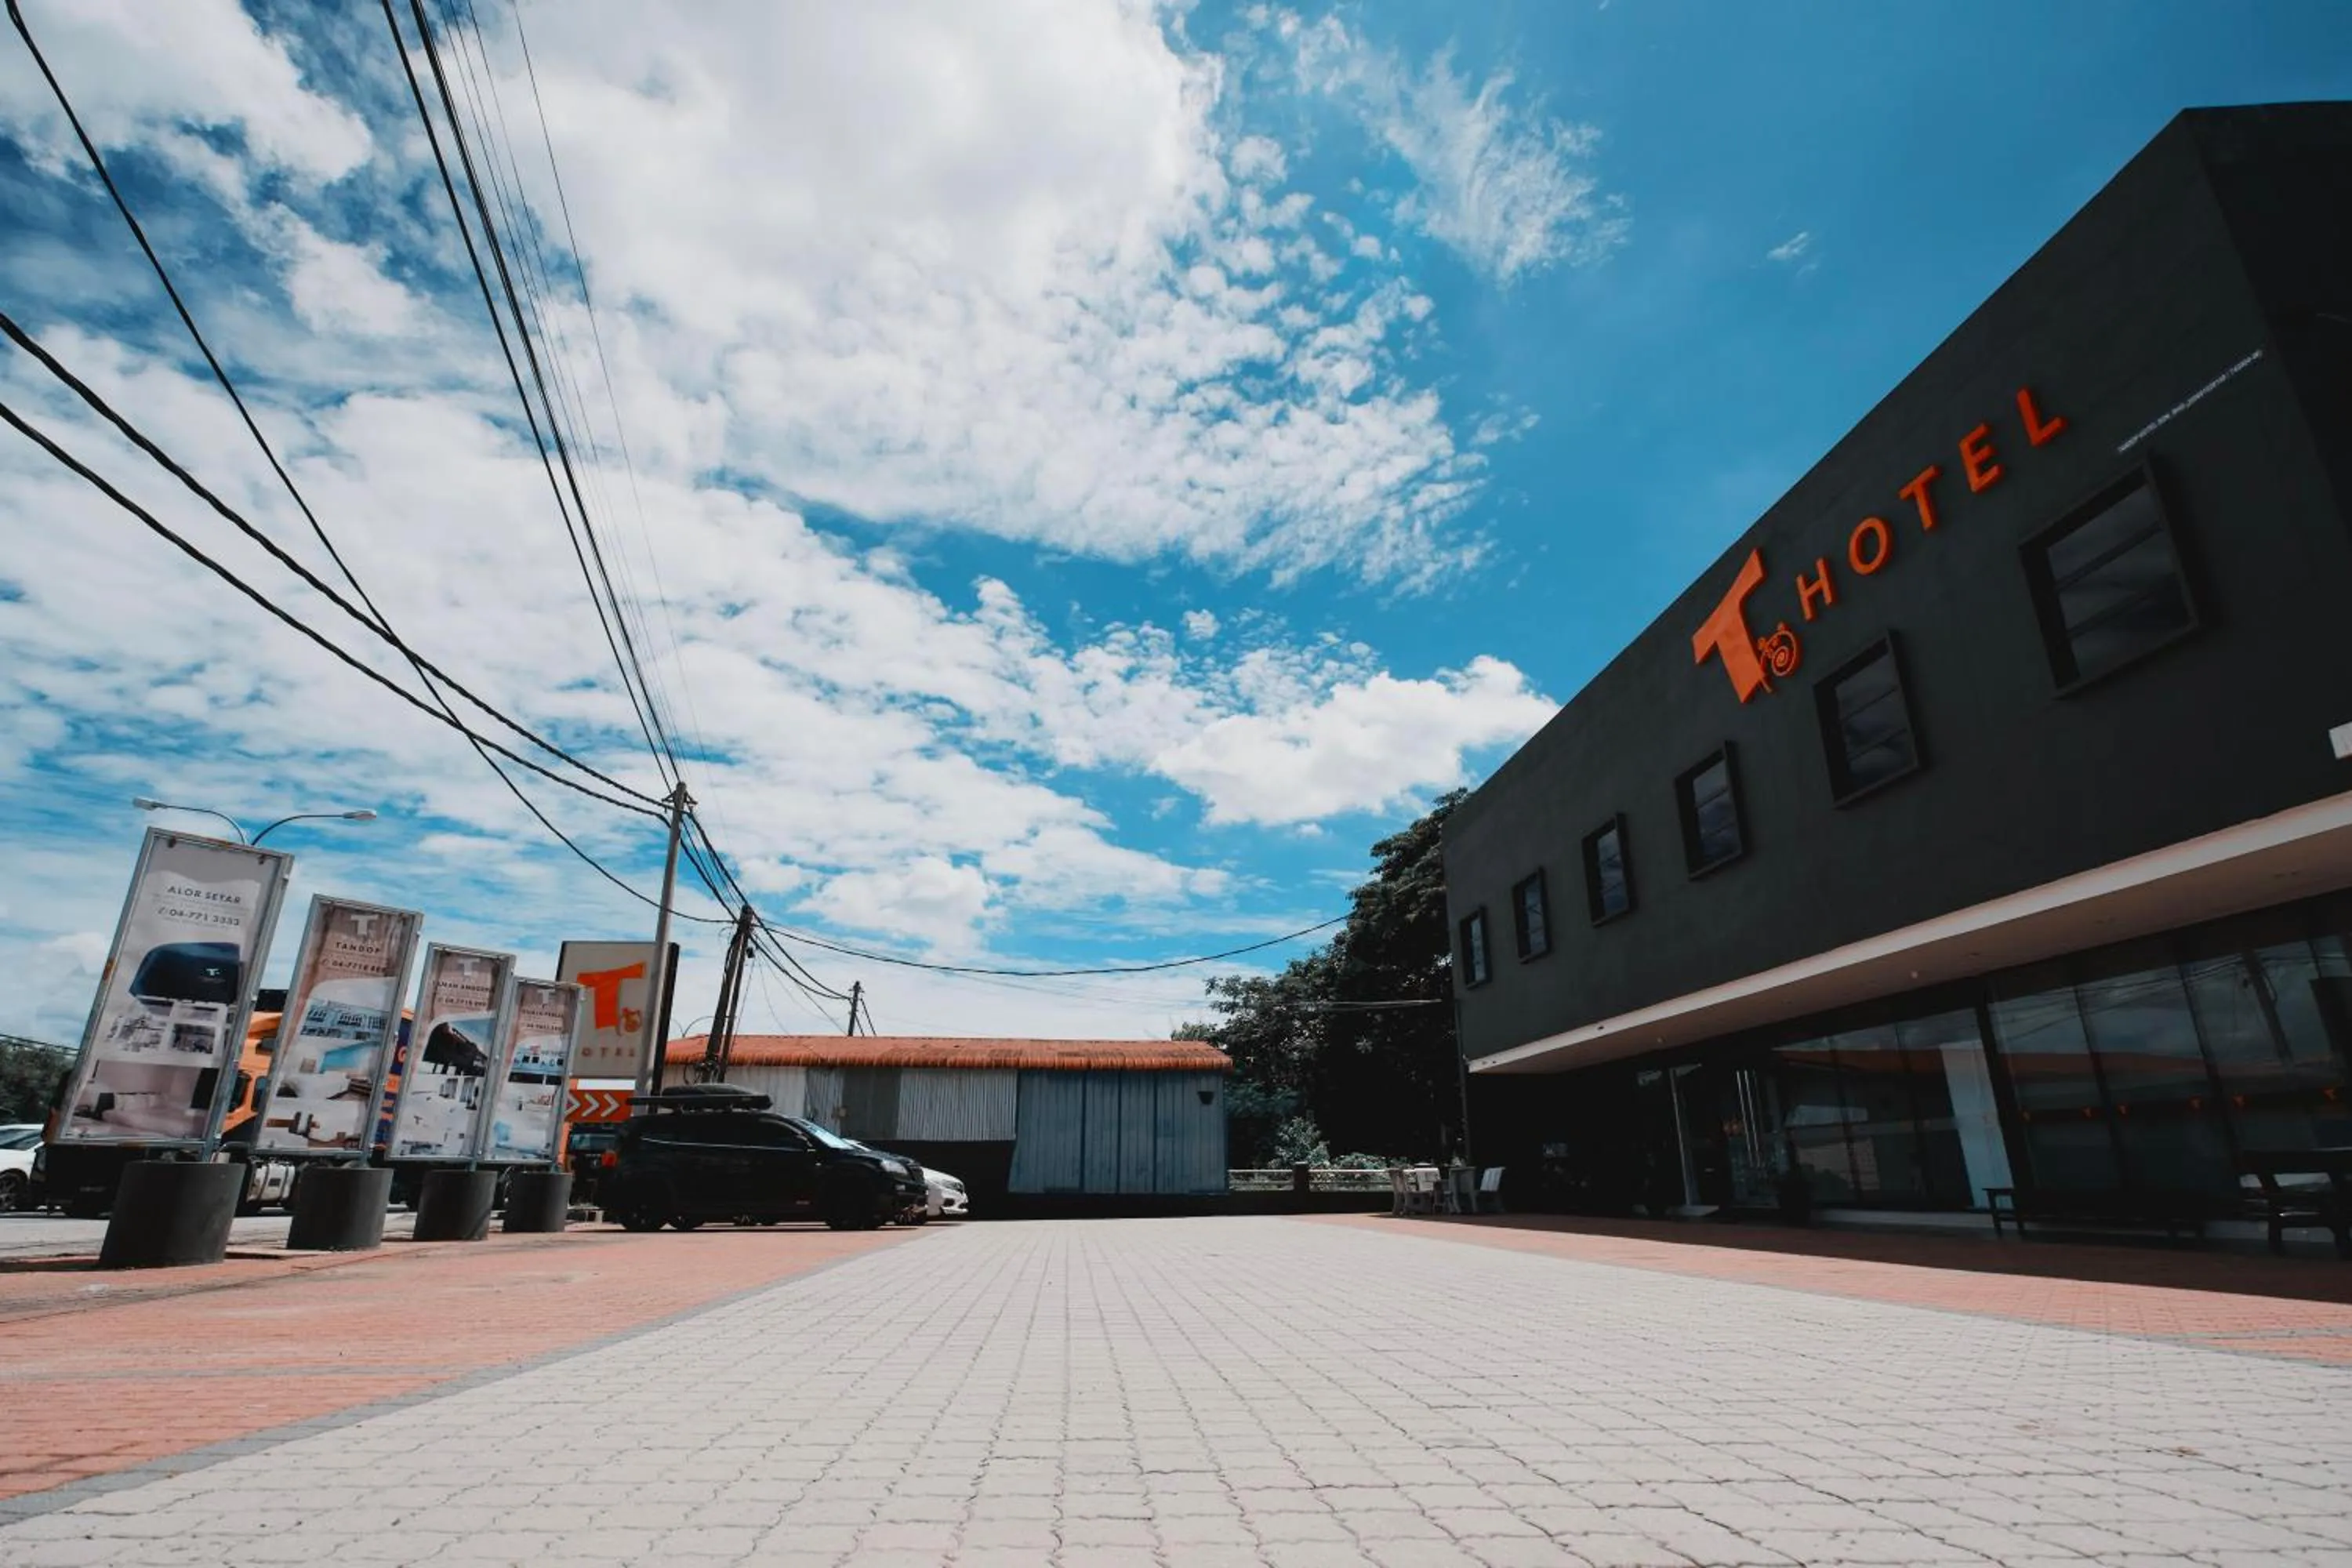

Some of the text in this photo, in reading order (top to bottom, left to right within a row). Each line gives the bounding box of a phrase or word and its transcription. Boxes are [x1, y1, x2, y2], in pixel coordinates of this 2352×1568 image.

[1795, 387, 2068, 621] HOTEL
[167, 885, 201, 898] ALOR
[581, 1046, 637, 1058] OTEL
